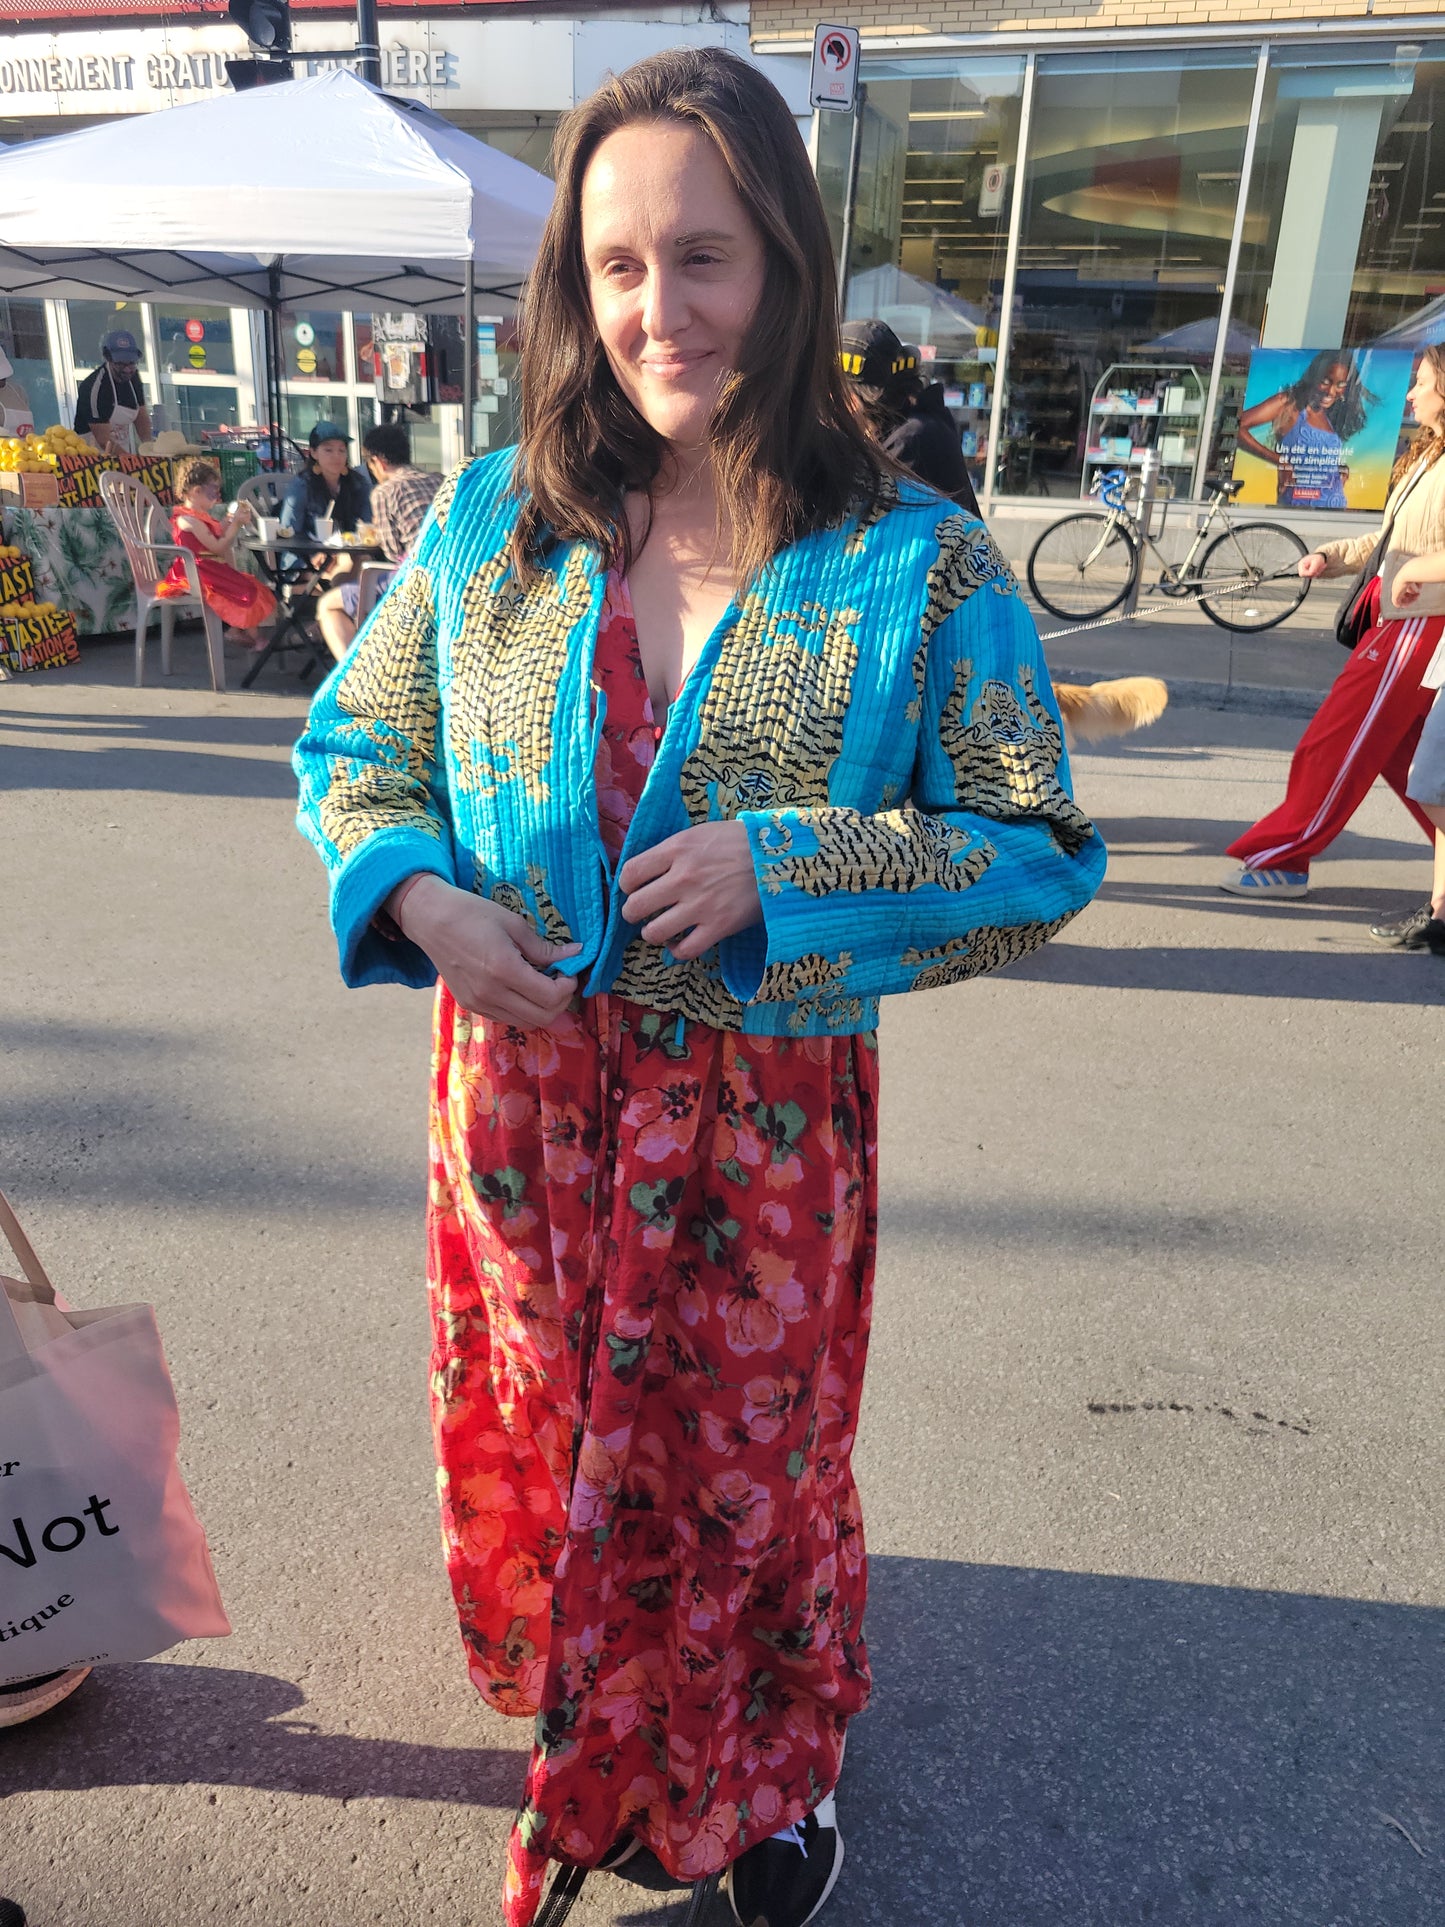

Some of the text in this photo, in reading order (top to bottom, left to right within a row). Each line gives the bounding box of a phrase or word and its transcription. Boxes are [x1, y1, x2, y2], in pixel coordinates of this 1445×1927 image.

[146, 52, 254, 87] GRATU
[1275, 443, 1354, 456] Un été en beauté
[1278, 455, 1289, 464] et
[1290, 457, 1302, 465] en
[21, 634, 64, 669] NATION
